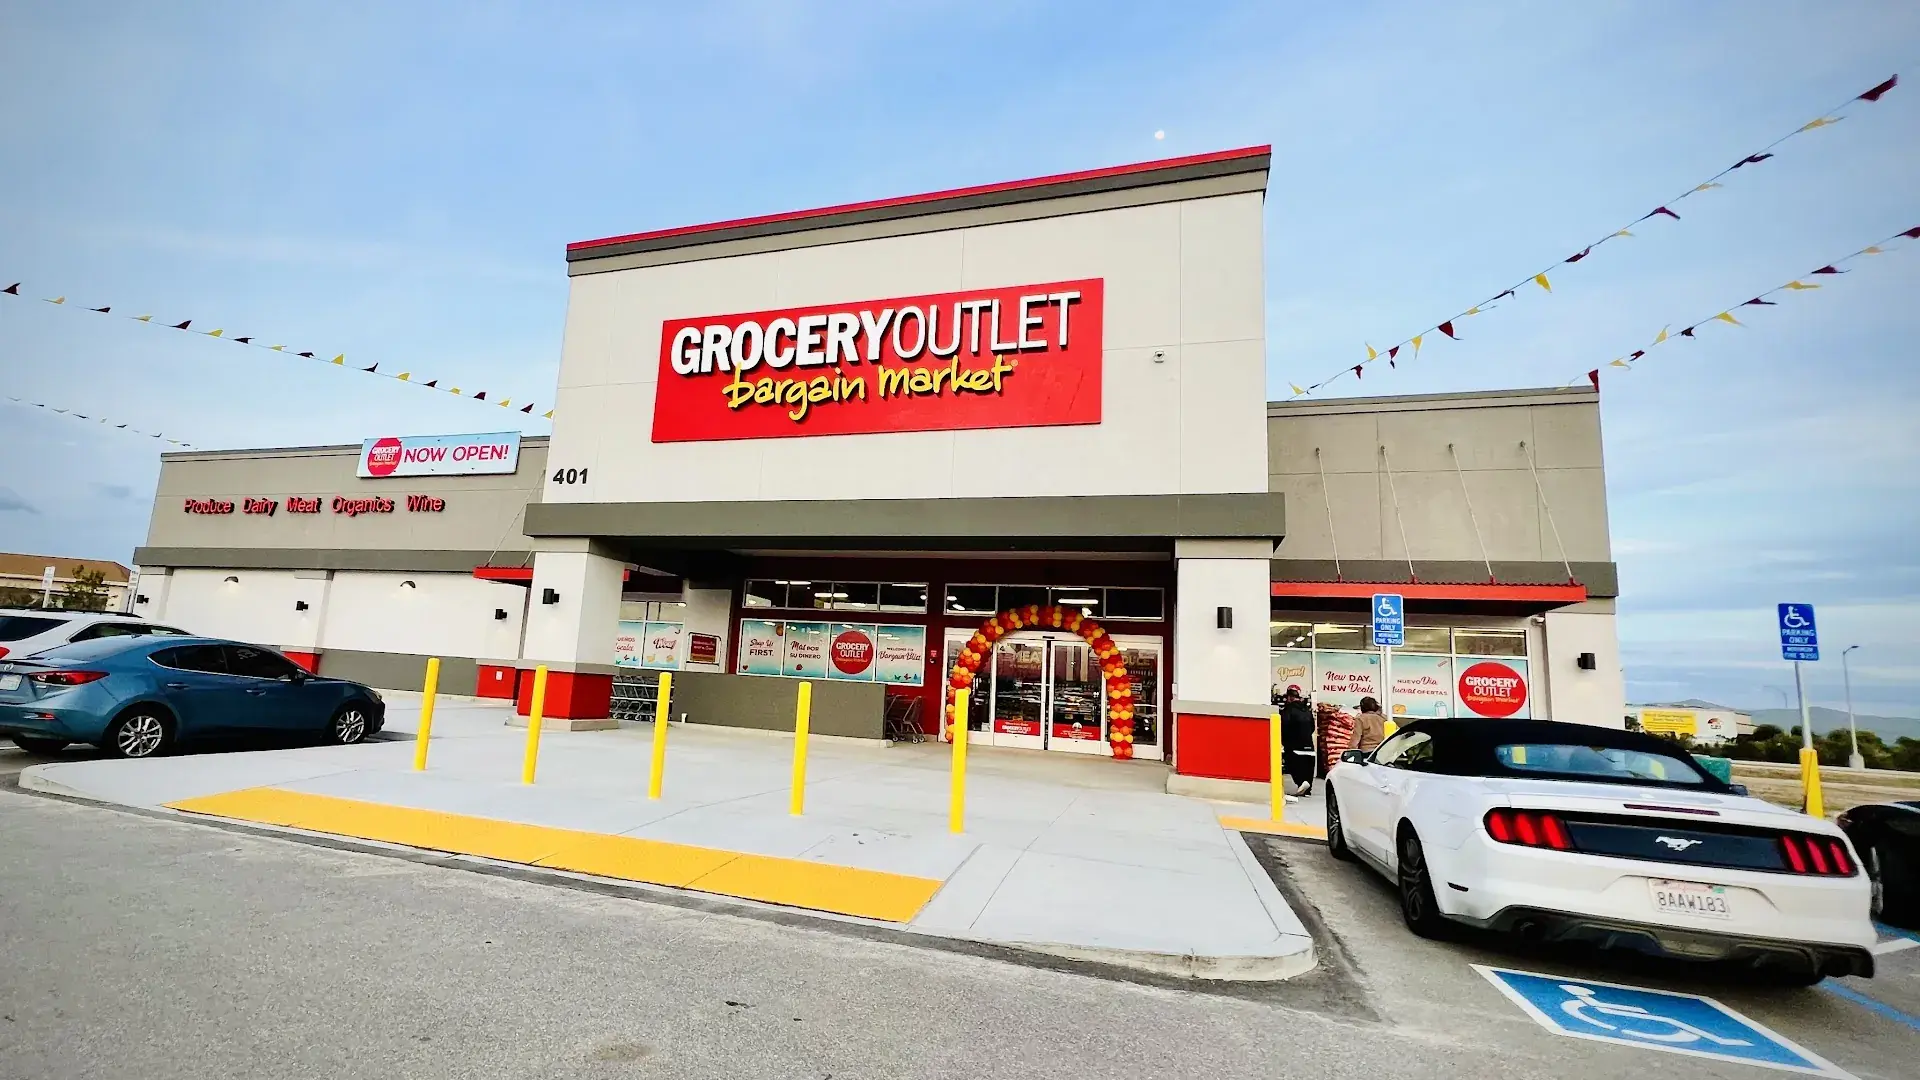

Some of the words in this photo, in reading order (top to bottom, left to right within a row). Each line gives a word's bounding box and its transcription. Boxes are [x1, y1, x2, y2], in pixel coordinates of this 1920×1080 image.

[722, 362, 865, 420] bargain
[878, 355, 1013, 396] market
[404, 448, 448, 463] NOW
[452, 445, 509, 462] OPEN!
[553, 468, 588, 484] 401
[184, 498, 234, 514] Produce
[242, 497, 278, 516] Dairy
[286, 497, 321, 513] Meat
[331, 495, 394, 517] Organics
[406, 495, 445, 512] Wine
[1376, 617, 1400, 625] PARKING
[1782, 628, 1815, 637] PARKING
[1788, 636, 1809, 644] ONLY
[835, 642, 869, 651] GROCERY
[749, 648, 774, 657] FIRST.
[839, 649, 865, 658] OUTLET
[1277, 665, 1306, 682] Yum!
[1325, 671, 1346, 681] New
[1349, 674, 1371, 682] DAY.
[1465, 676, 1519, 688] GROCERY
[1323, 684, 1346, 692] NEW
[1473, 687, 1512, 697] OUTLET
[1656, 891, 1726, 913] 8AAW183
